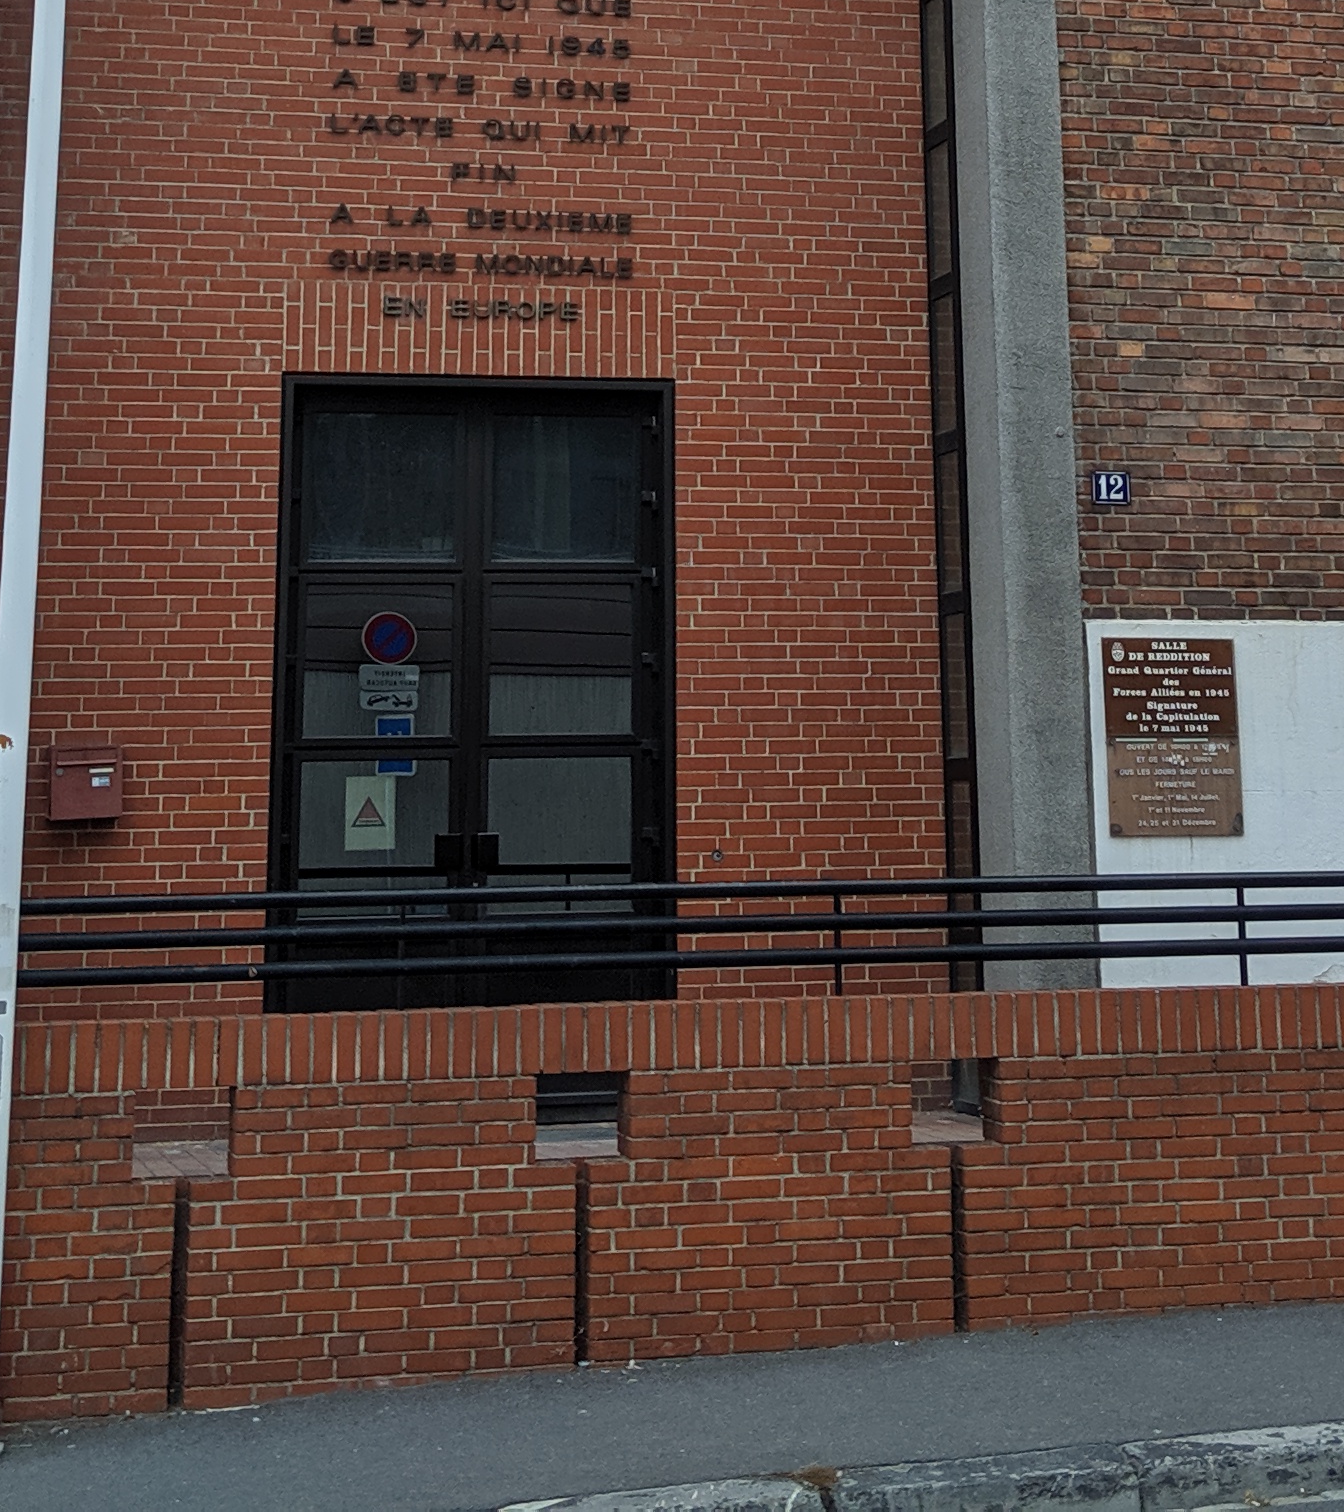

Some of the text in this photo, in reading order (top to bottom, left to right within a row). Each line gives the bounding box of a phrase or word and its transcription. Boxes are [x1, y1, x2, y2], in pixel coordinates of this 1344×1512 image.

[332, 23, 631, 59] LE 7 MAI 1945
[332, 68, 358, 90] A
[329, 113, 631, 145] L'ACTE QUI MIT
[451, 161, 517, 183] FIN
[387, 205, 432, 227] LA
[467, 207, 632, 235] DEUXIEME
[329, 249, 633, 280] GUERRE MONDIALE
[383, 295, 579, 322] EN EUROPE
[1098, 475, 1124, 500] 12
[1128, 652, 1210, 661] DE REDDITION
[1151, 642, 1187, 650] SALLE
[1108, 666, 1232, 675] Grand Quartier Général
[1113, 688, 1146, 696] Forces
[1151, 688, 1185, 696] Alliées
[1147, 702, 1198, 711] Signature
[1157, 713, 1220, 722] Capitulation
[1139, 724, 1149, 732] le
